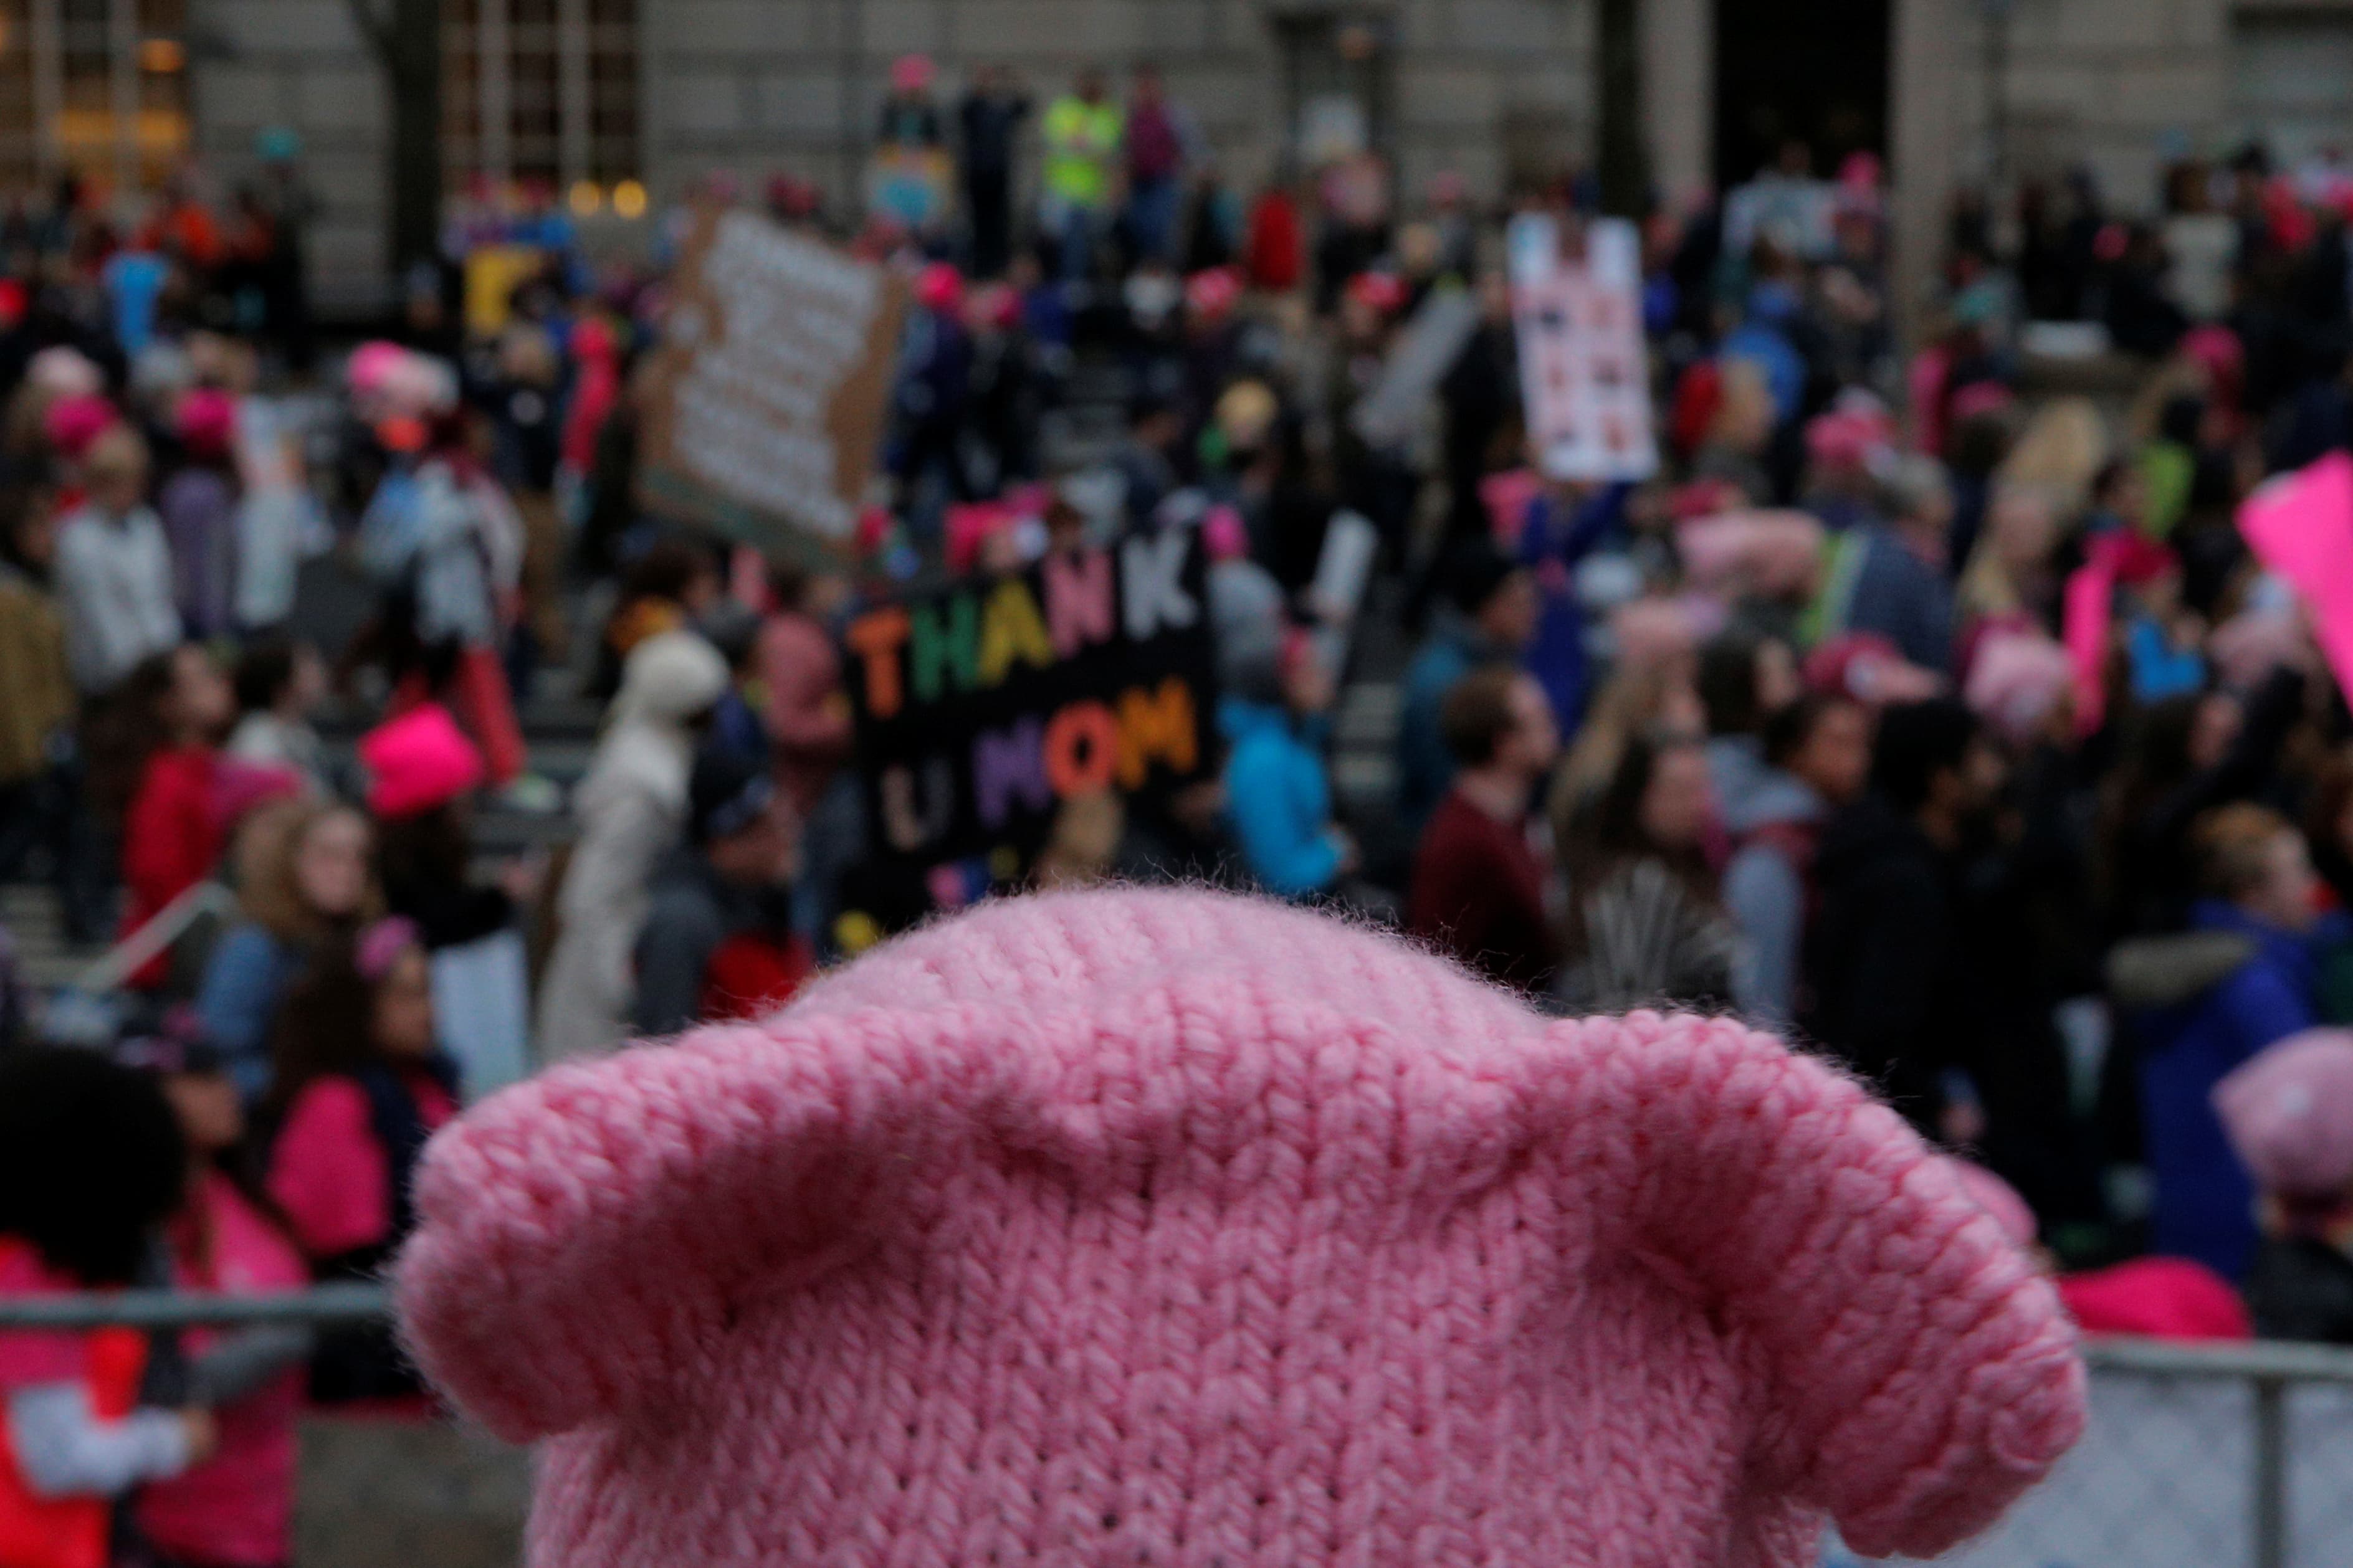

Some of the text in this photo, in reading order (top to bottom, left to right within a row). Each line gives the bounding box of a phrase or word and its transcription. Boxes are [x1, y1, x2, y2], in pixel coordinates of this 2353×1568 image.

[845, 530, 1199, 722] THANK
[879, 673, 1200, 852] U MOM
